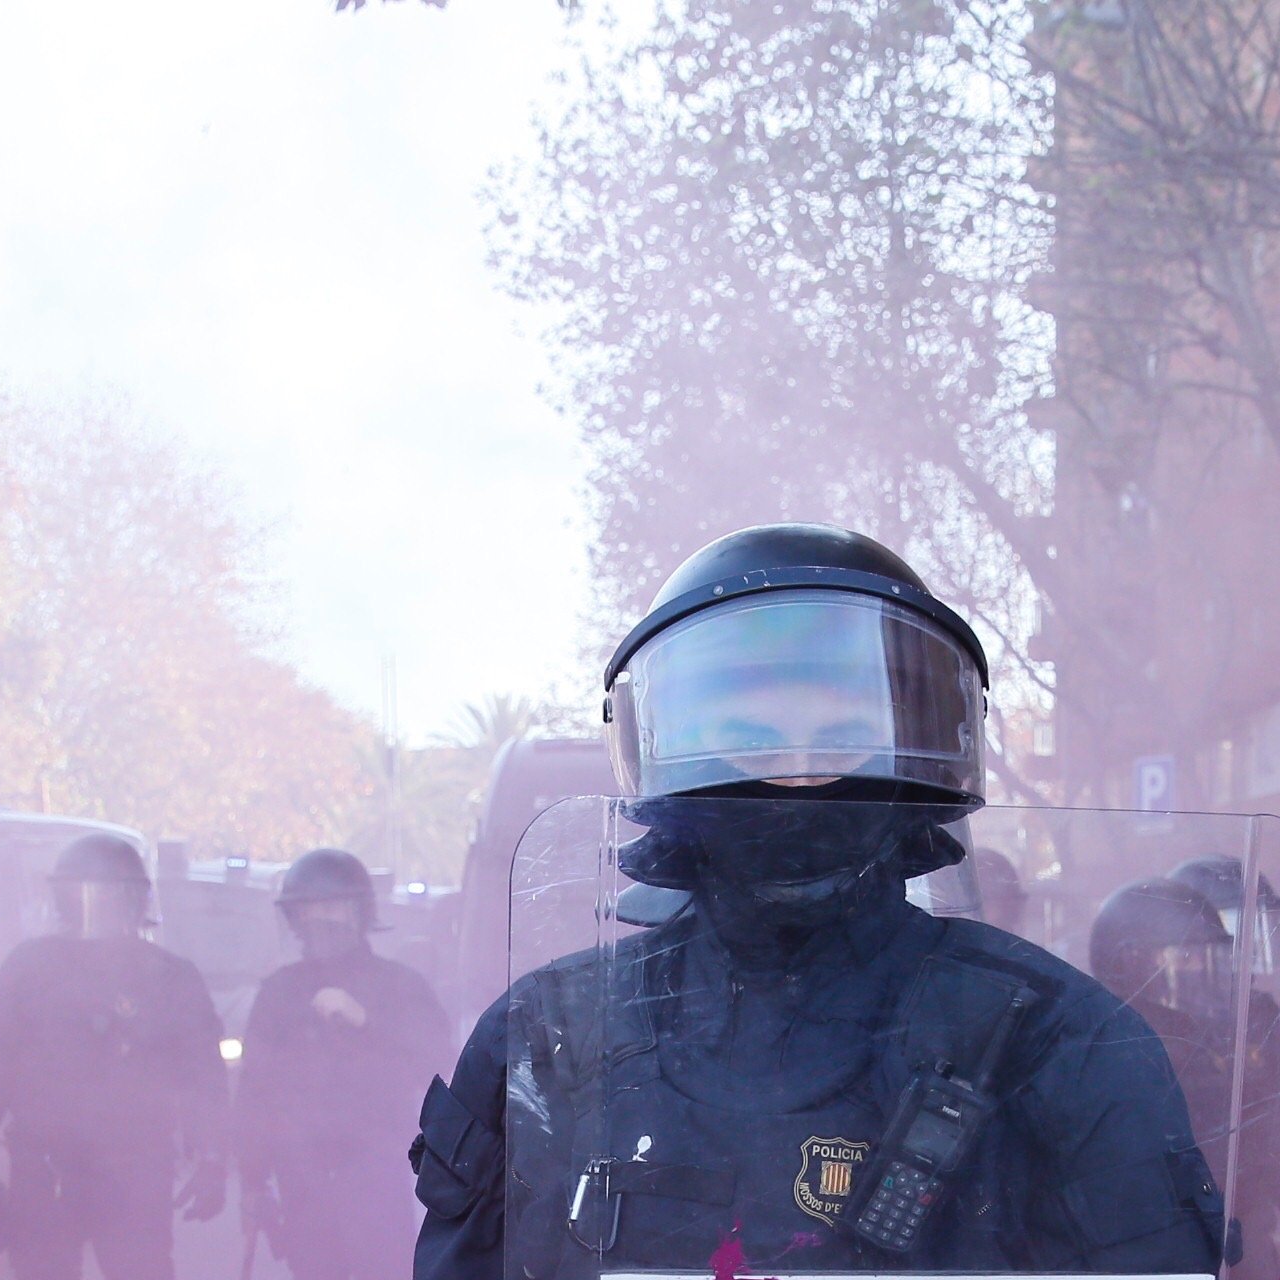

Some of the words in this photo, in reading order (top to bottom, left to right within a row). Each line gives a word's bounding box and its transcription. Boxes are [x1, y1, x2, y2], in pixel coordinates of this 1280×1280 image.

[1141, 765, 1167, 810] P
[812, 1145, 863, 1161] POLICIA
[799, 1182, 824, 1211] MOSSOS
[824, 1202, 843, 1214] D'E
